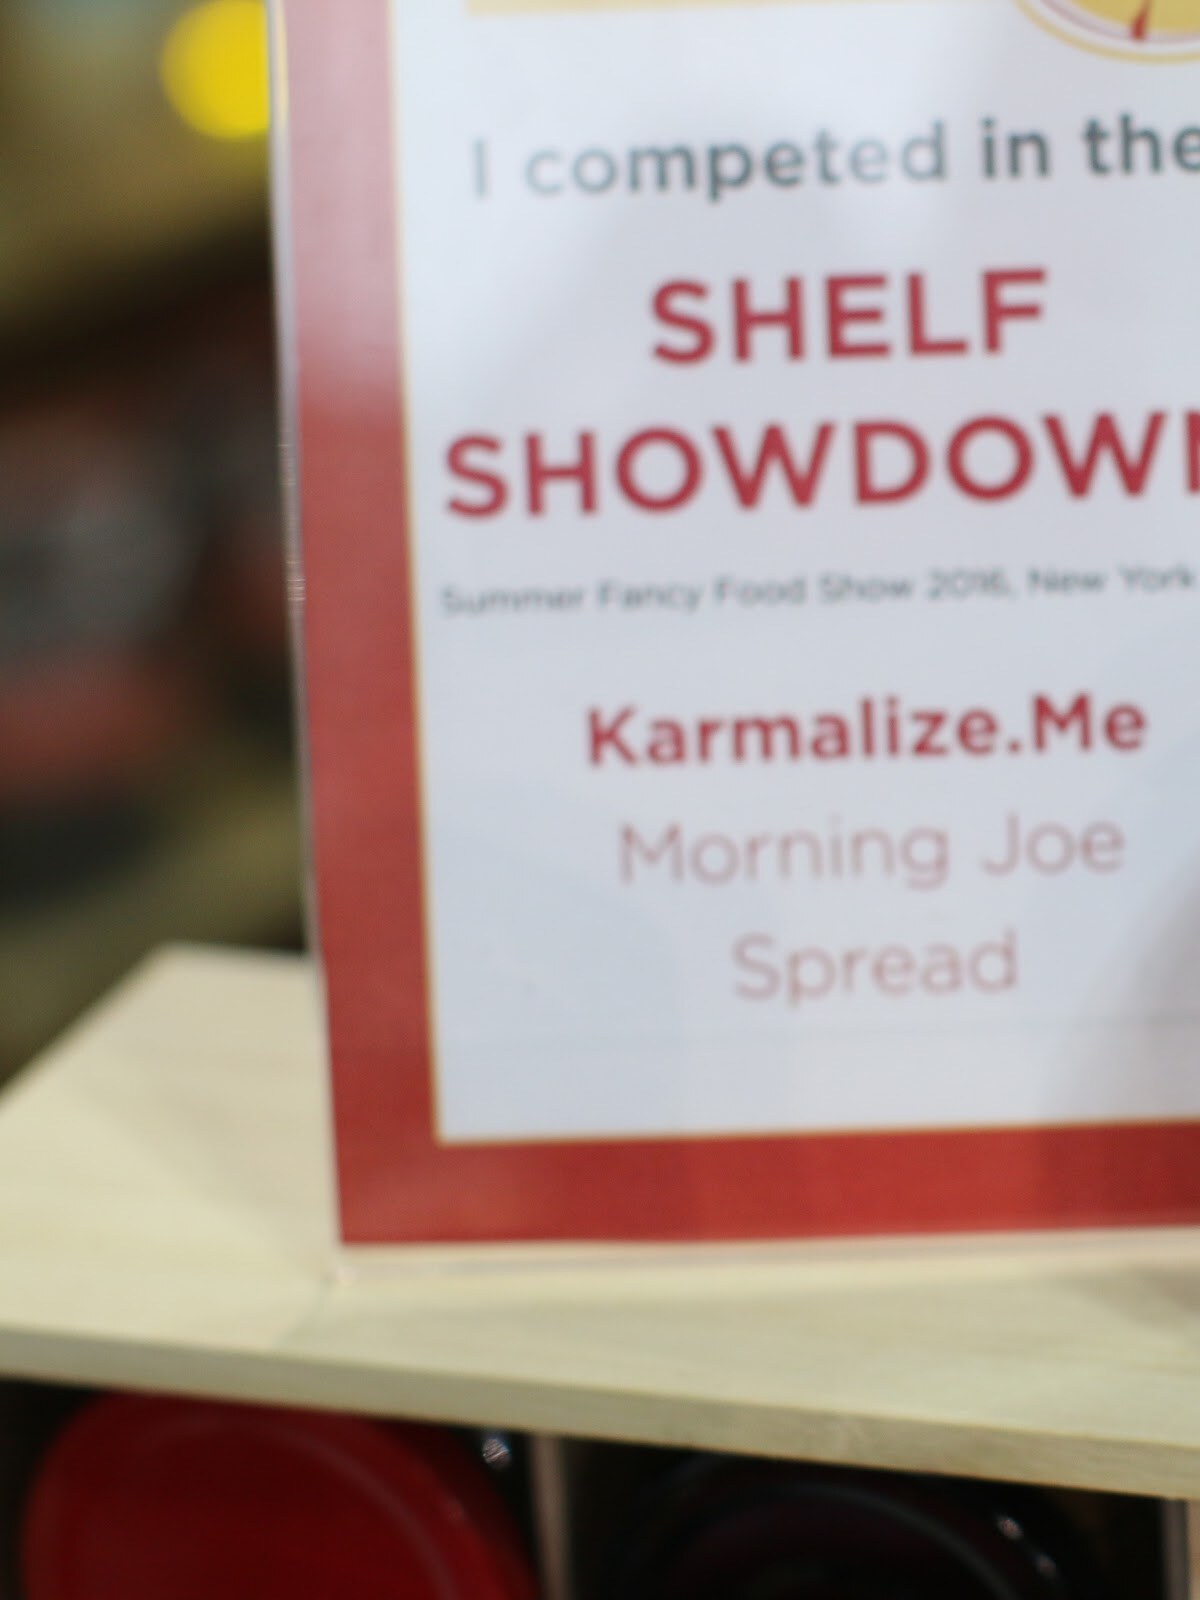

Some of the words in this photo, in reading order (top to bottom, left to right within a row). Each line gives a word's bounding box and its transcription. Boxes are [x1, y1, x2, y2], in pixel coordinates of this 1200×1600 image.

[470, 138, 490, 198] I
[524, 119, 948, 204] competed
[978, 116, 1052, 180] in
[650, 267, 1050, 366] SHELF
[440, 584, 585, 616] Summer
[597, 574, 703, 614] Fancy
[713, 572, 808, 608] Food
[819, 570, 914, 606] Show
[928, 565, 1012, 602] 2016,
[1026, 565, 1106, 597] New
[1117, 561, 1196, 595] York
[586, 692, 1148, 768] Karmalize.Me
[617, 815, 950, 891] Morning
[980, 813, 1127, 874] Joe
[730, 930, 1020, 1007] Spread
